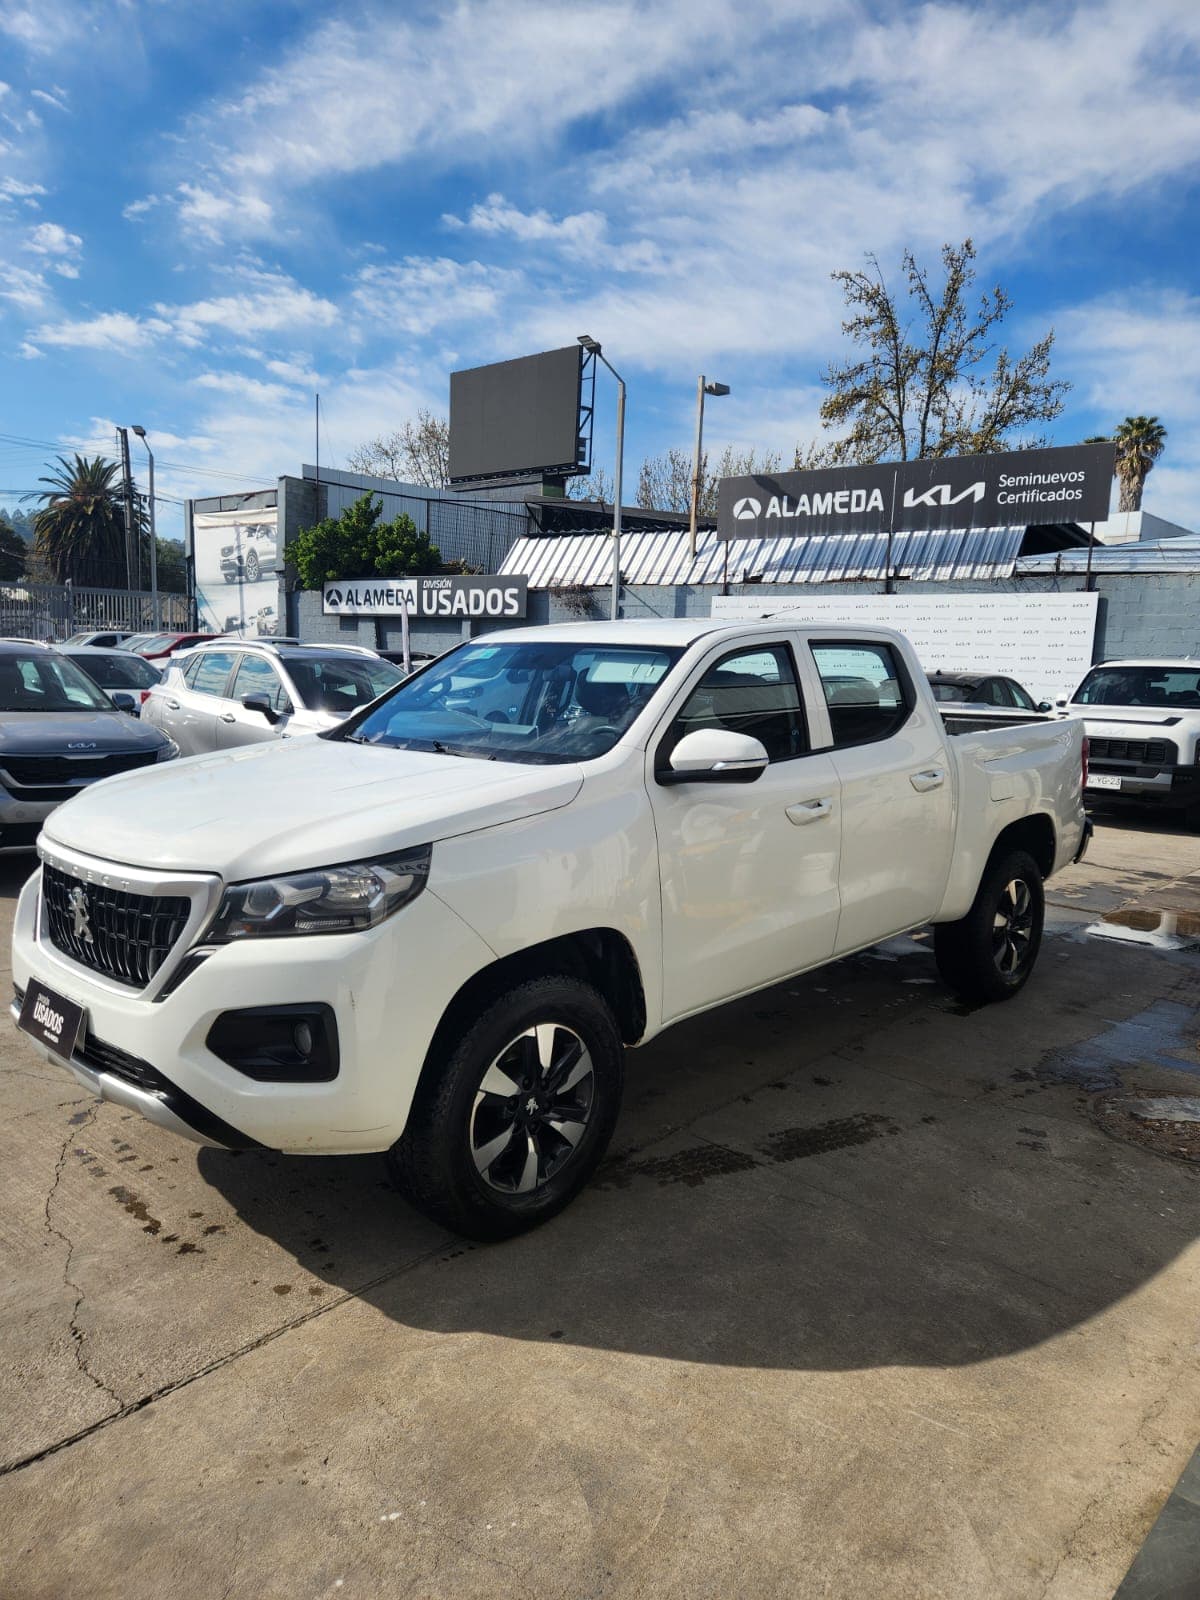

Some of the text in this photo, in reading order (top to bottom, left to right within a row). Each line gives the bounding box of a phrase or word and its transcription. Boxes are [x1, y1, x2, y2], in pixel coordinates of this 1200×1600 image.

[998, 469, 1085, 487] Seminuevos
[765, 488, 884, 519] ALAMEDA
[904, 481, 986, 508] KIA
[997, 487, 1083, 505] Certificados
[422, 578, 453, 589] DIVISIÓN
[345, 588, 415, 606] ALAMEDA
[422, 587, 520, 616] USADOS
[33, 1000, 65, 1034] USADOS
